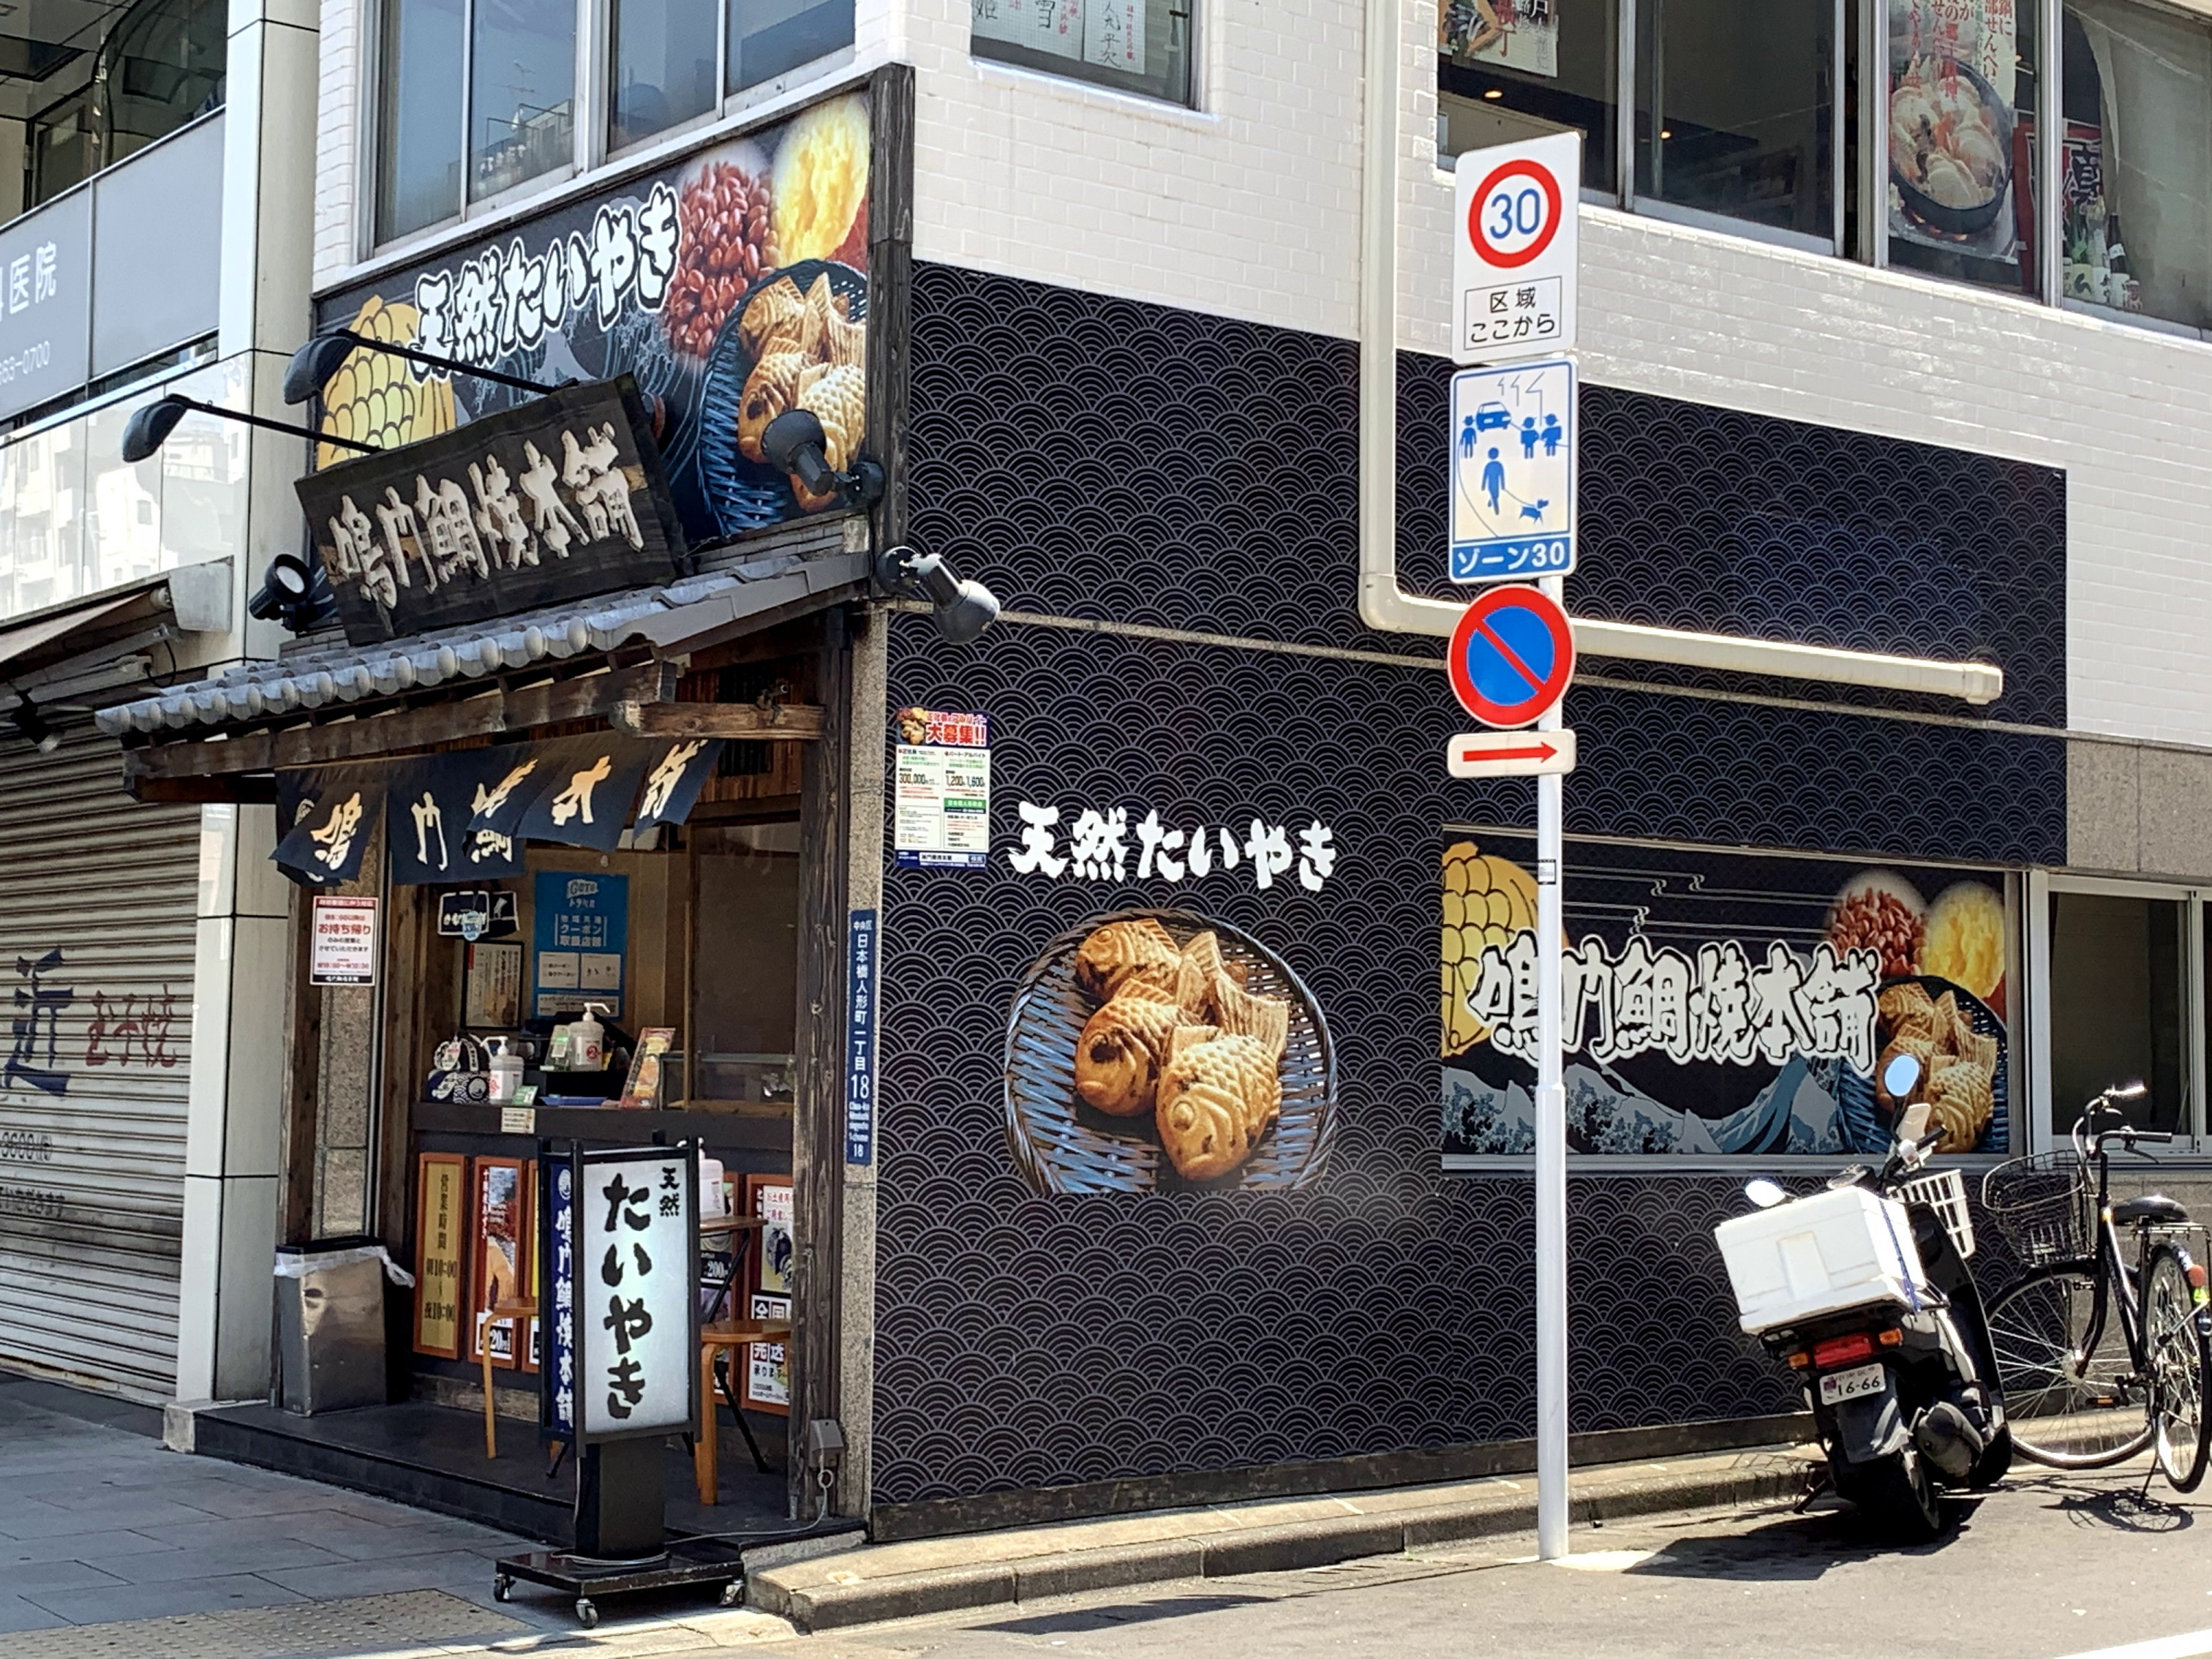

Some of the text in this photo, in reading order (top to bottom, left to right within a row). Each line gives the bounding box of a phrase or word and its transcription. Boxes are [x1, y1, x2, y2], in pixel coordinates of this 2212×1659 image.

[1490, 188, 1540, 239] 30
[0, 241, 57, 322] 医院
[1490, 286, 1536, 314] 区域
[1470, 313, 1555, 343] ここから
[1457, 541, 1565, 575] ゾーン30
[1008, 801, 1336, 892] 天然たいやき
[318, 924, 371, 935] お持ち帰り
[850, 1073, 870, 1099] 18
[854, 1143, 864, 1157] 18
[659, 1166, 680, 1218] 天然
[601, 1172, 653, 1420] たいやき
[1837, 1375, 1881, 1396] 16-66
